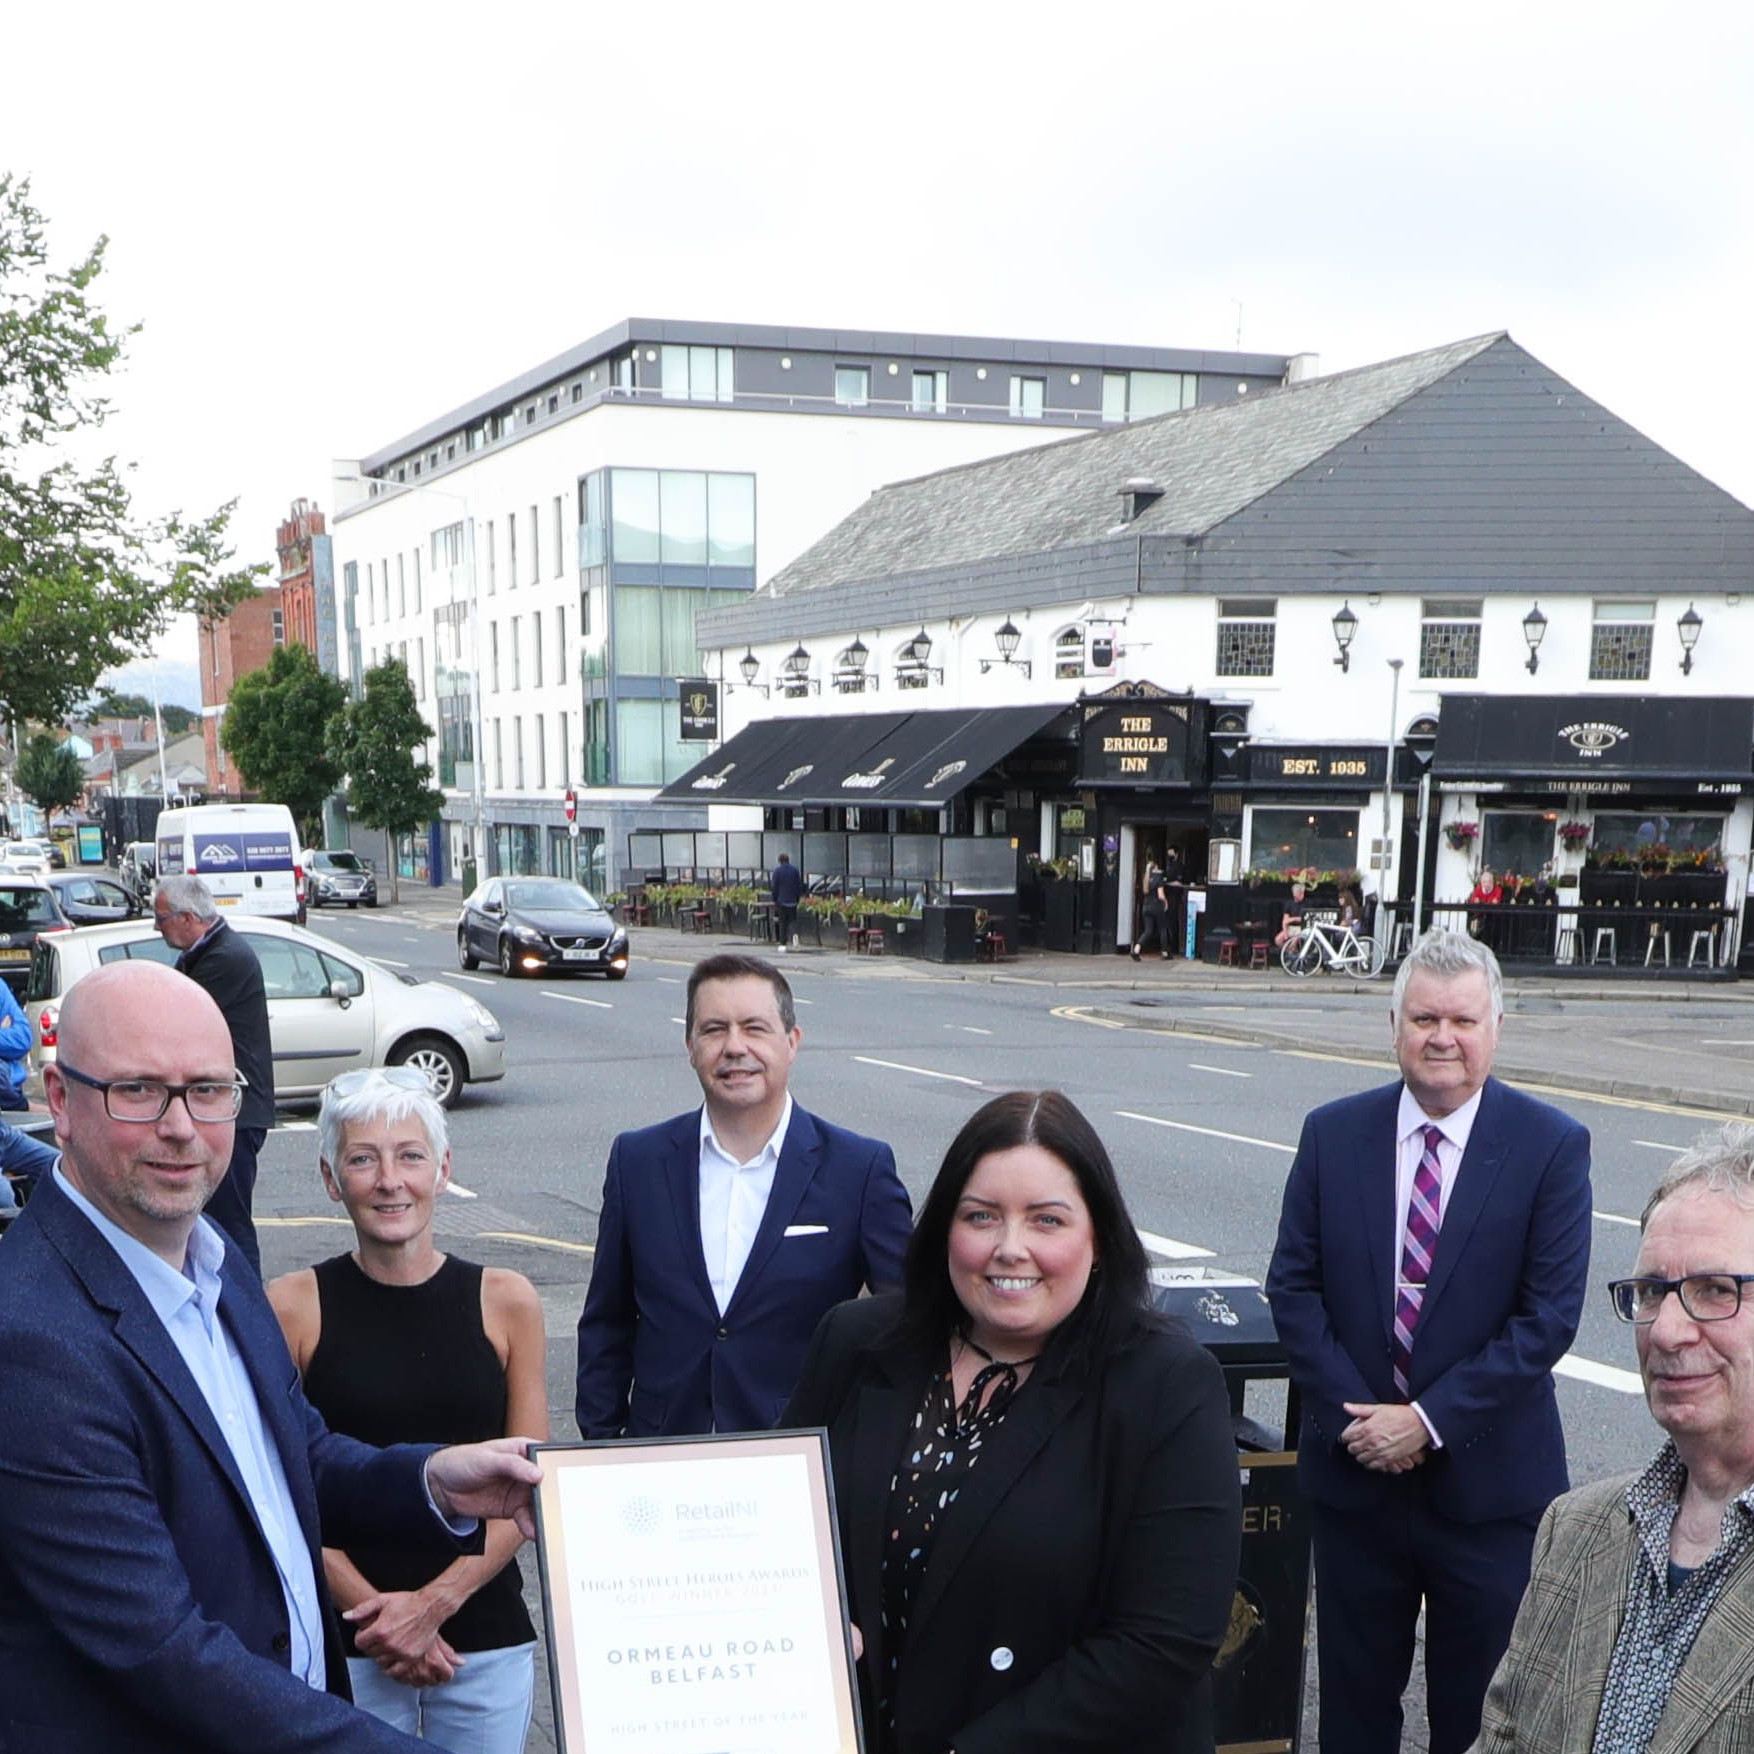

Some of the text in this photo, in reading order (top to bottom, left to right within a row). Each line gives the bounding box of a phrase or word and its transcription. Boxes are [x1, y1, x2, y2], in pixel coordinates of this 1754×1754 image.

[1120, 717, 1152, 732] THE
[1558, 723, 1582, 740] THE
[1103, 737, 1168, 752] ERRIGLE
[1578, 748, 1603, 758] INN
[1120, 757, 1149, 772] INN
[1547, 781, 1569, 792] THE
[607, 1637, 795, 1666] ORMEAU ROAD
[651, 1662, 758, 1686] BELFAST
